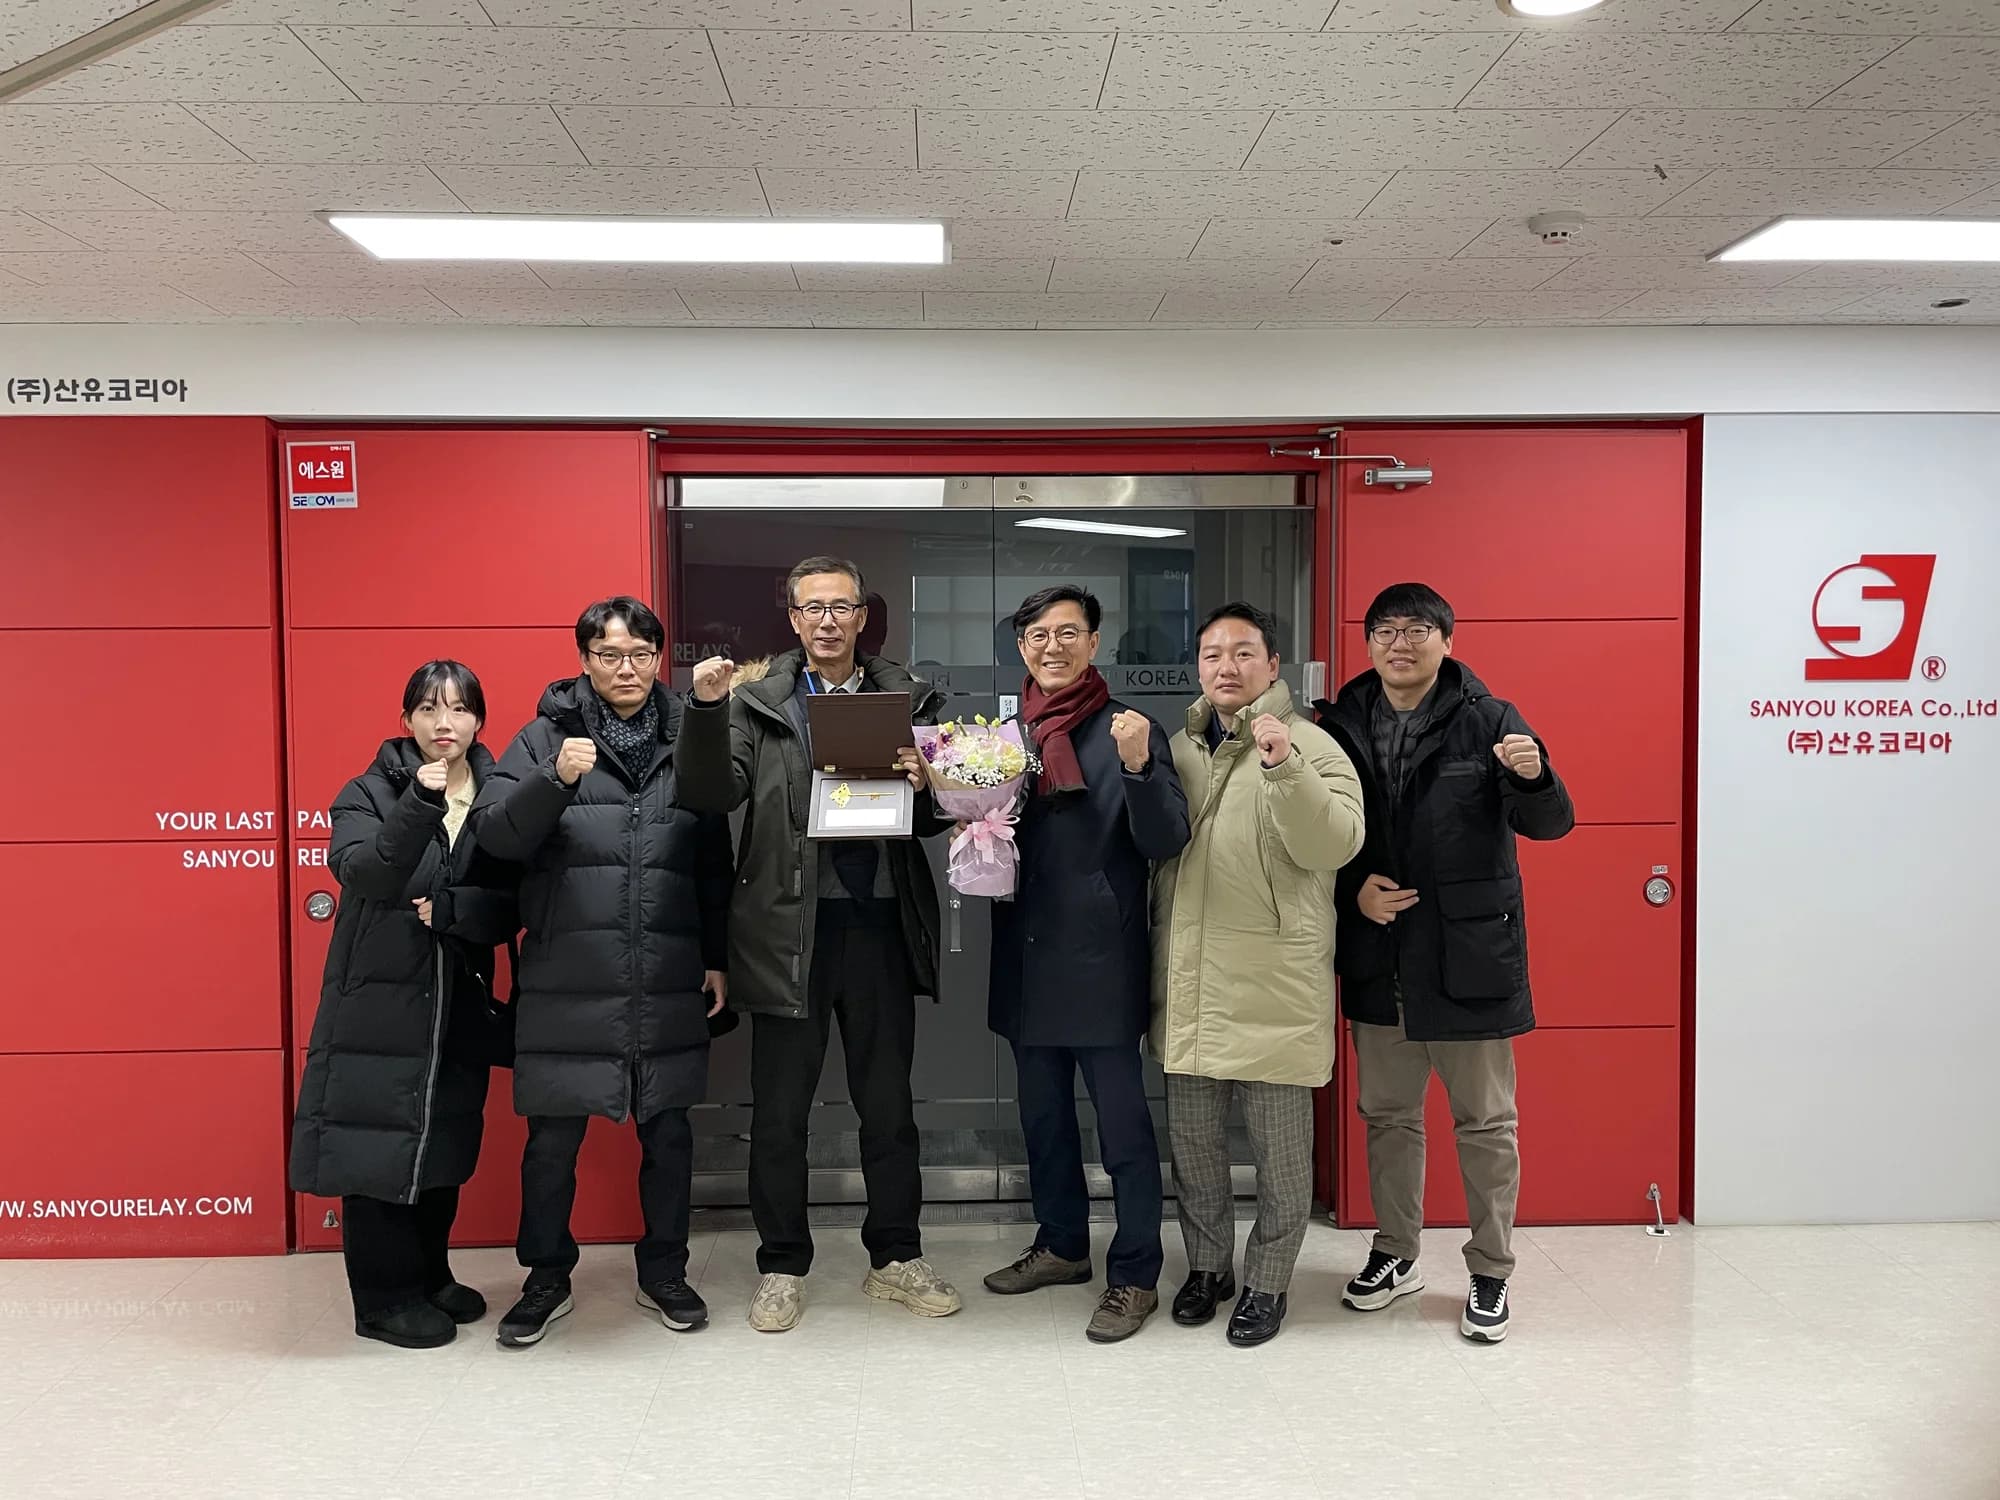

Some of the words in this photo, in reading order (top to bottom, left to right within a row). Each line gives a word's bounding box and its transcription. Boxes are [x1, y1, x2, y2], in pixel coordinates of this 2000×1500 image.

[7, 378, 188, 403] (주)산유코리아
[298, 460, 344, 479] 에스원
[293, 496, 335, 506] SECOM
[673, 642, 732, 662] RELAYS
[1125, 670, 1190, 686] KOREA
[1750, 700, 1836, 717] SANYOU
[1844, 700, 1913, 717] KOREA
[1921, 700, 1998, 718] Co.,Ltd
[1787, 729, 1953, 754] (주)산유코리아
[156, 812, 217, 830] YOUR
[226, 812, 275, 829] LAST
[183, 850, 275, 868] SANYOU
